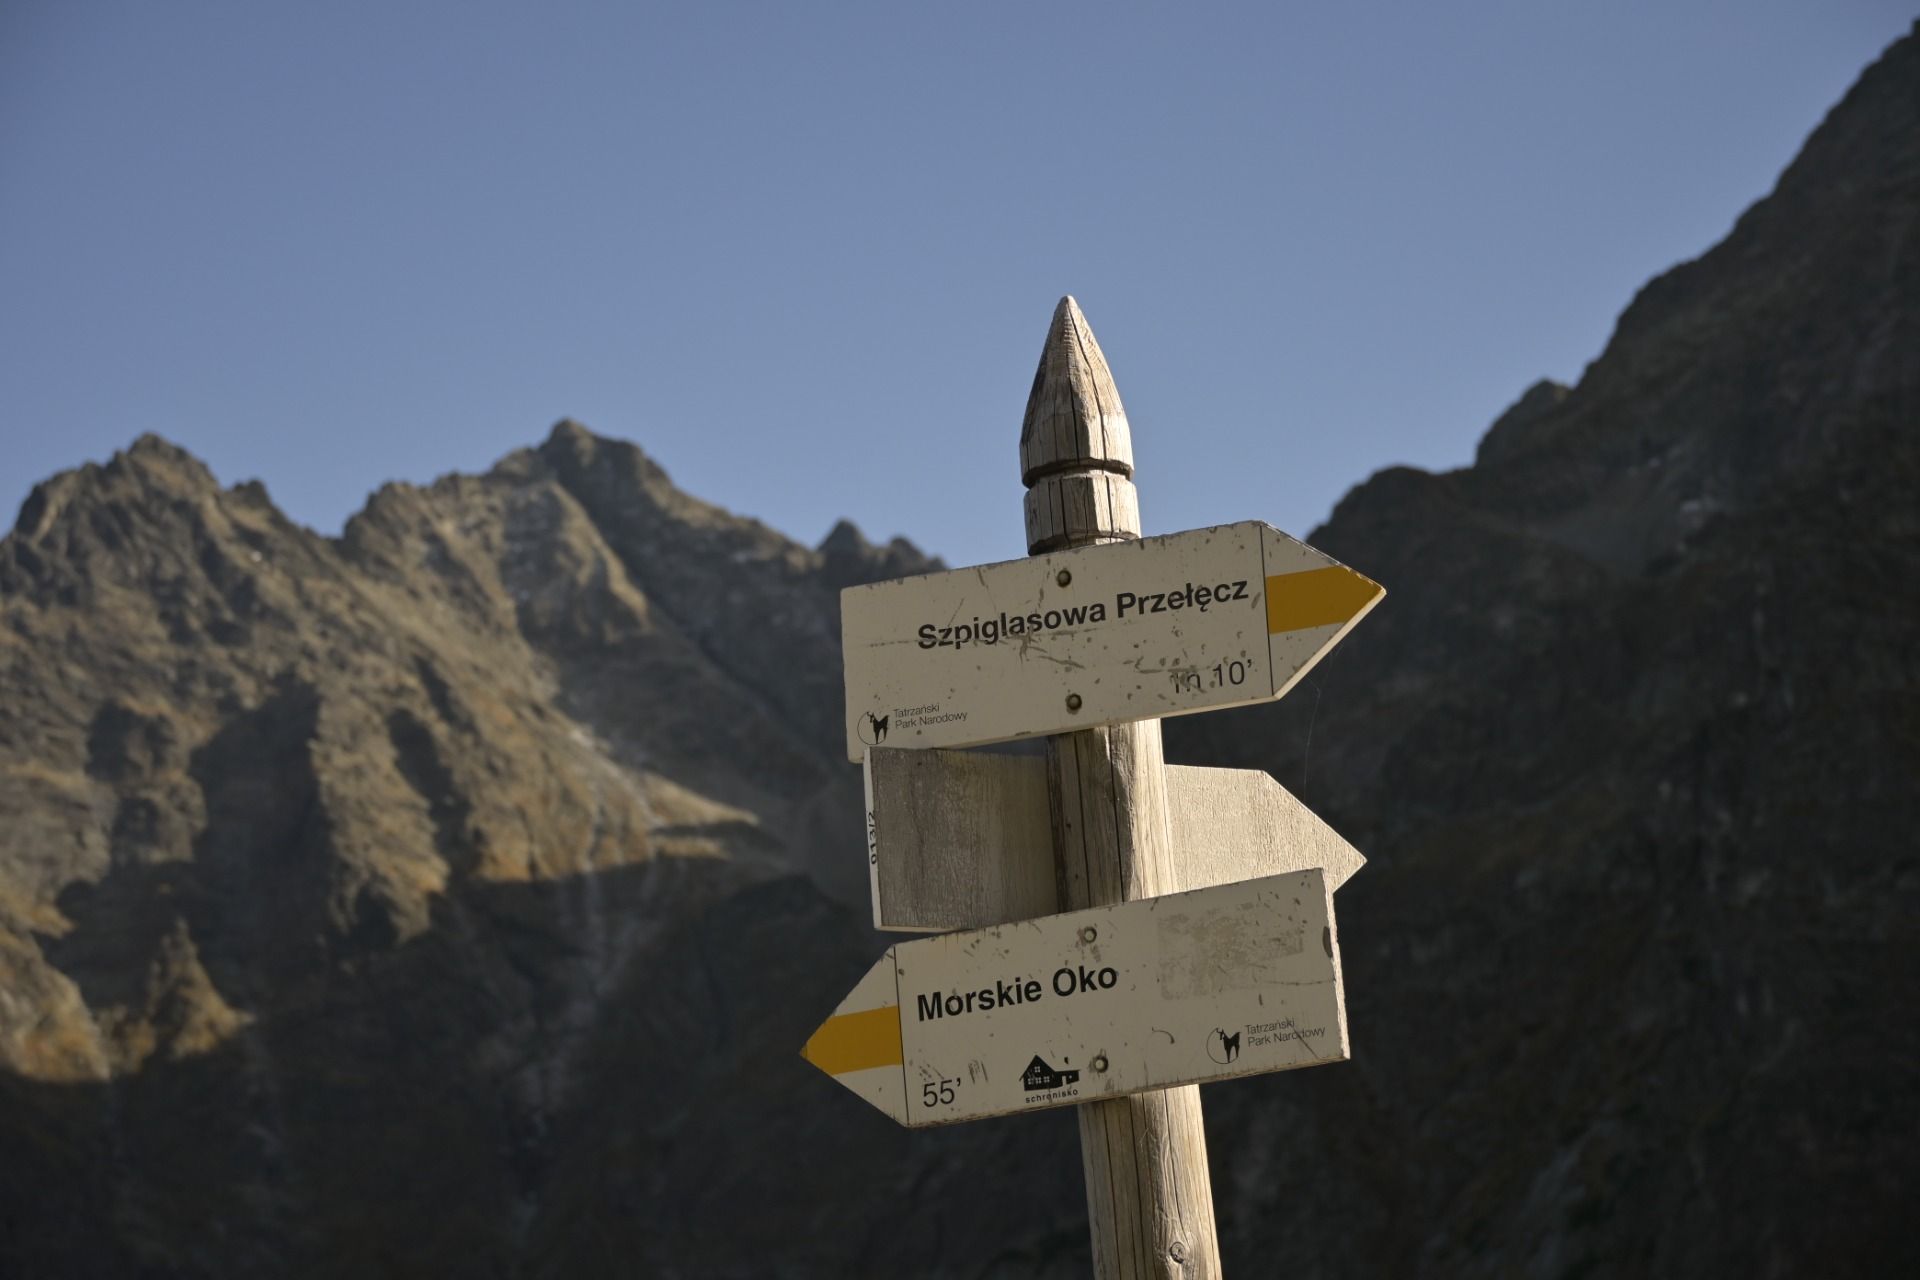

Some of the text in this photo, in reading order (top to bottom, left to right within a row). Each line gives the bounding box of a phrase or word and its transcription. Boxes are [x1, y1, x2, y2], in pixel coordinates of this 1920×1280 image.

[918, 580, 1249, 649] Szpiglasowa Przełęcz
[894, 702, 940, 718] Tatrzański
[895, 711, 968, 729] Park Narodowy
[917, 965, 1118, 1021] Morskie Oko
[1245, 1016, 1296, 1035] Tatrzański
[1248, 1026, 1326, 1047] Park Narodowy
[1025, 1088, 1079, 1104] schronisko
